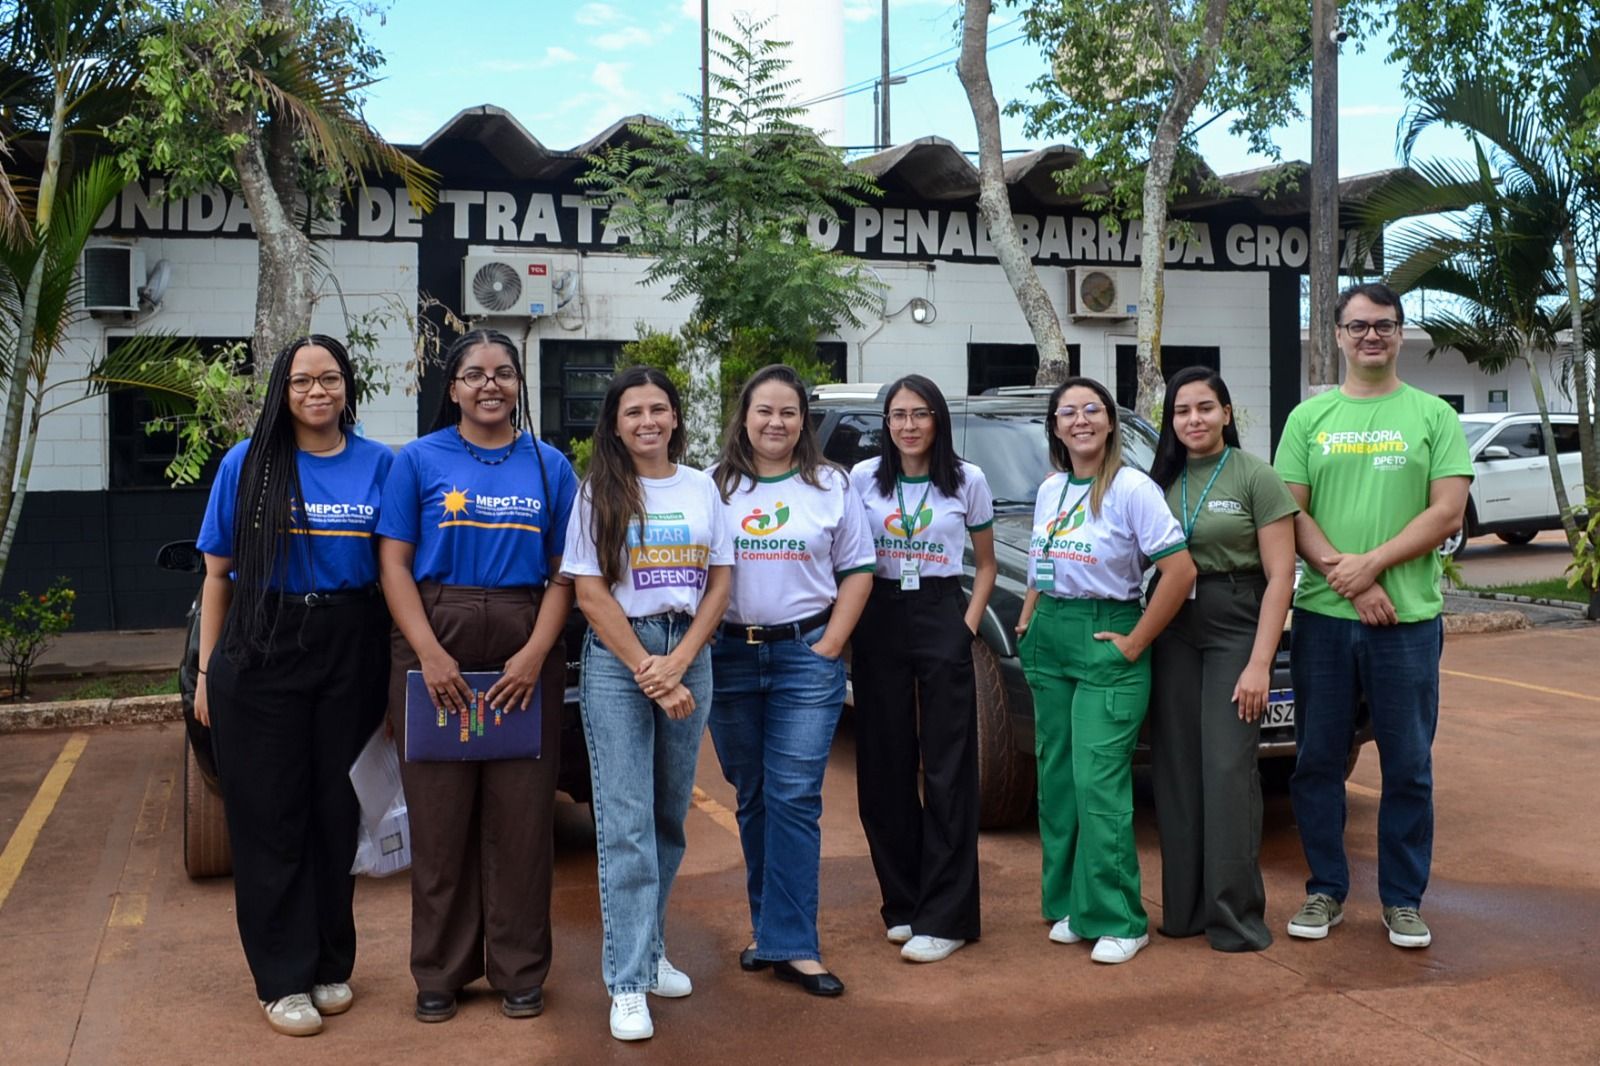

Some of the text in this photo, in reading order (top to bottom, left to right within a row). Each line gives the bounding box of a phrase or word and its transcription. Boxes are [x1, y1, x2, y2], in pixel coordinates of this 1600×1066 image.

[358, 187, 423, 238] DE
[1324, 430, 1403, 444] DEFENSORIA
[304, 502, 374, 516] MEPCT-TO
[476, 494, 541, 510] MEPCT-TO
[735, 536, 806, 551] fensores
[873, 535, 944, 553] efensores
[636, 548, 705, 565] ACOLHER
